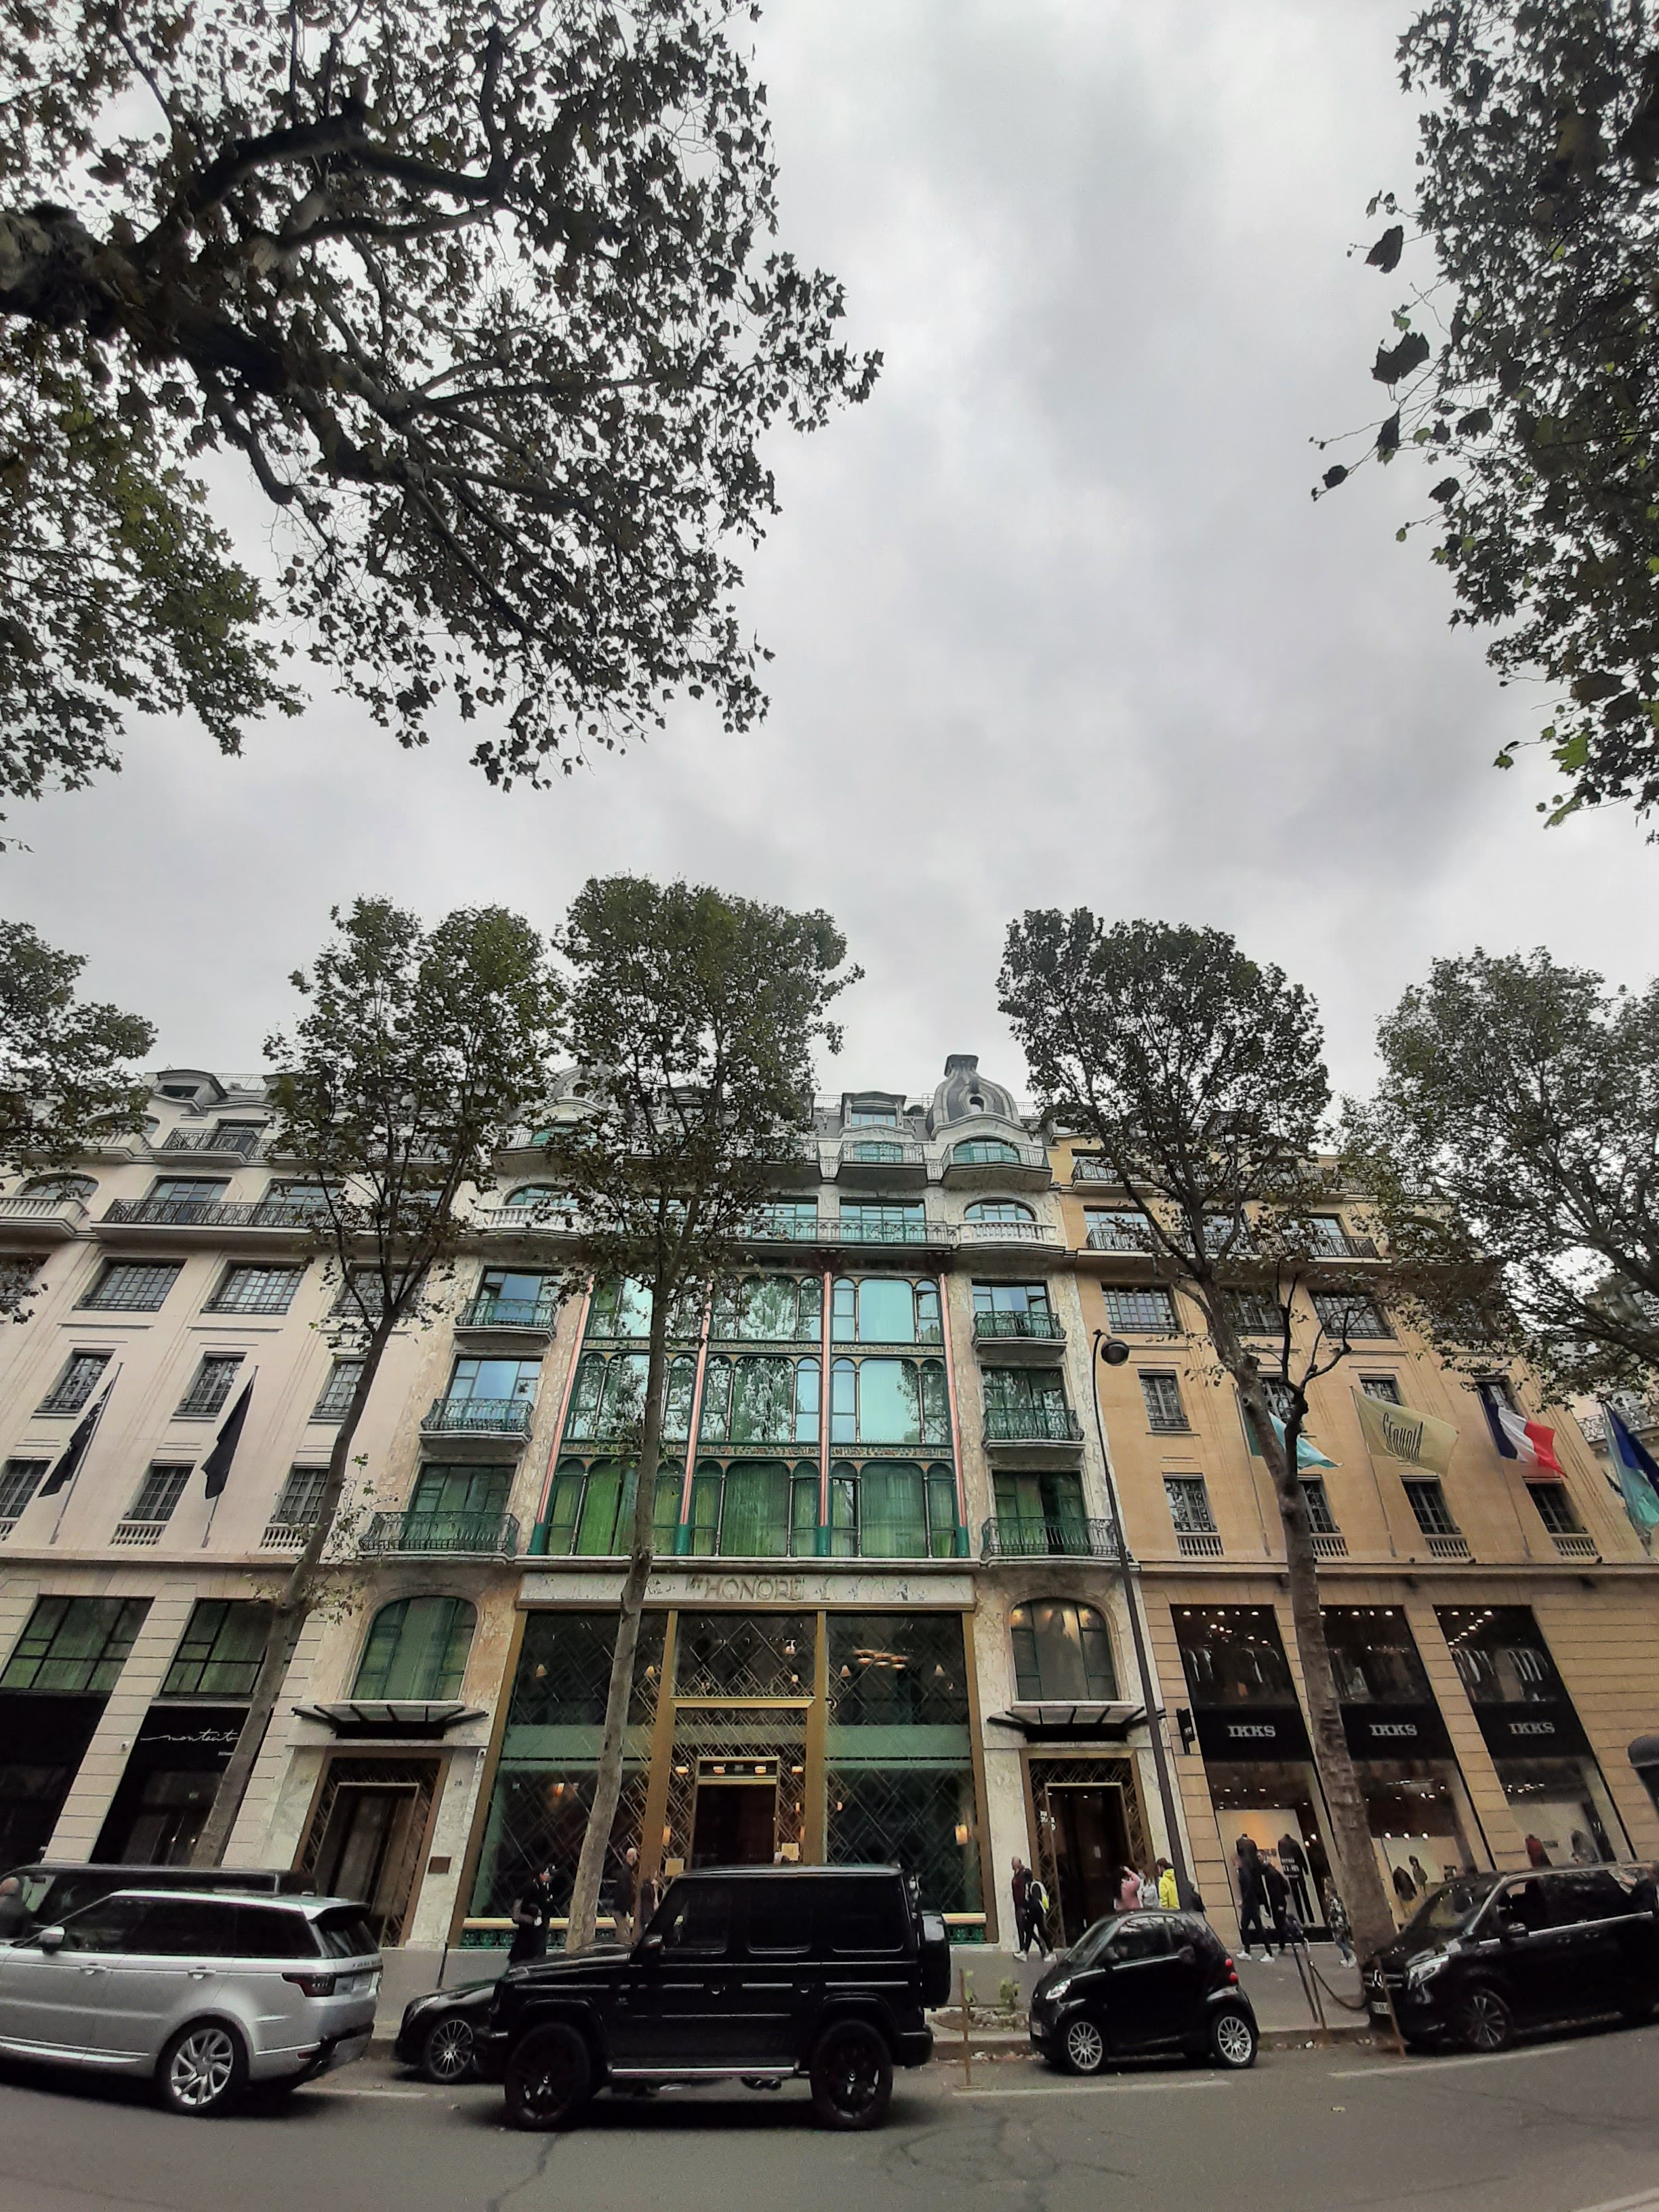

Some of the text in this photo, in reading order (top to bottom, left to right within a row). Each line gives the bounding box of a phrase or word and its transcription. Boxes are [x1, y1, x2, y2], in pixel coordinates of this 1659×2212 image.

[1227, 1725, 1276, 1738] IKKS
[1370, 1724, 1418, 1736] IKKS
[1508, 1722, 1555, 1734] IKKS
